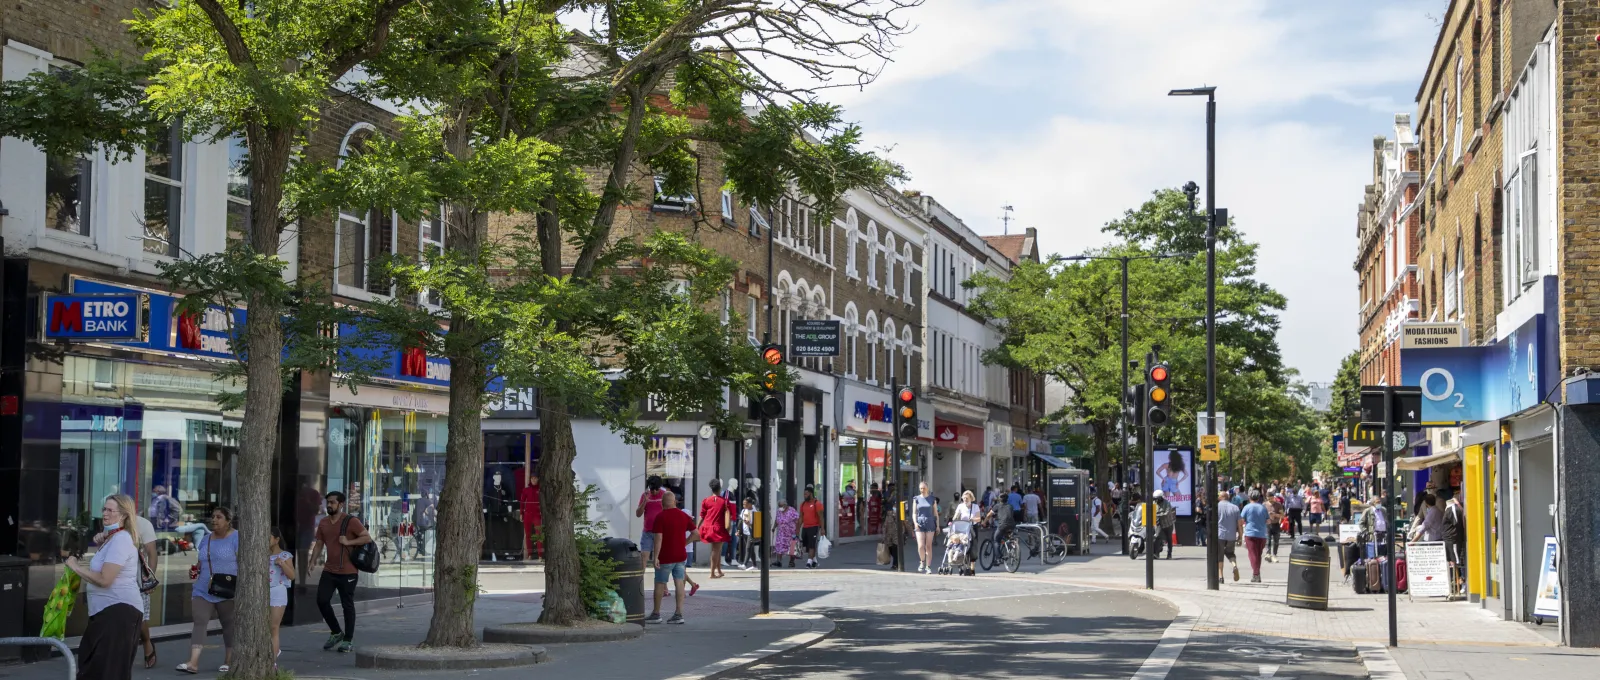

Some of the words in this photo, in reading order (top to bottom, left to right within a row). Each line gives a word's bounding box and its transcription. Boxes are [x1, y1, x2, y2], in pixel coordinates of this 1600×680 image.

[51, 301, 129, 333] METRO
[85, 320, 128, 332] BANK
[1405, 328, 1426, 336] MODA
[1427, 327, 1458, 335] ITALIANA
[200, 334, 233, 354] BANK
[1414, 337, 1449, 345] FASHIONS
